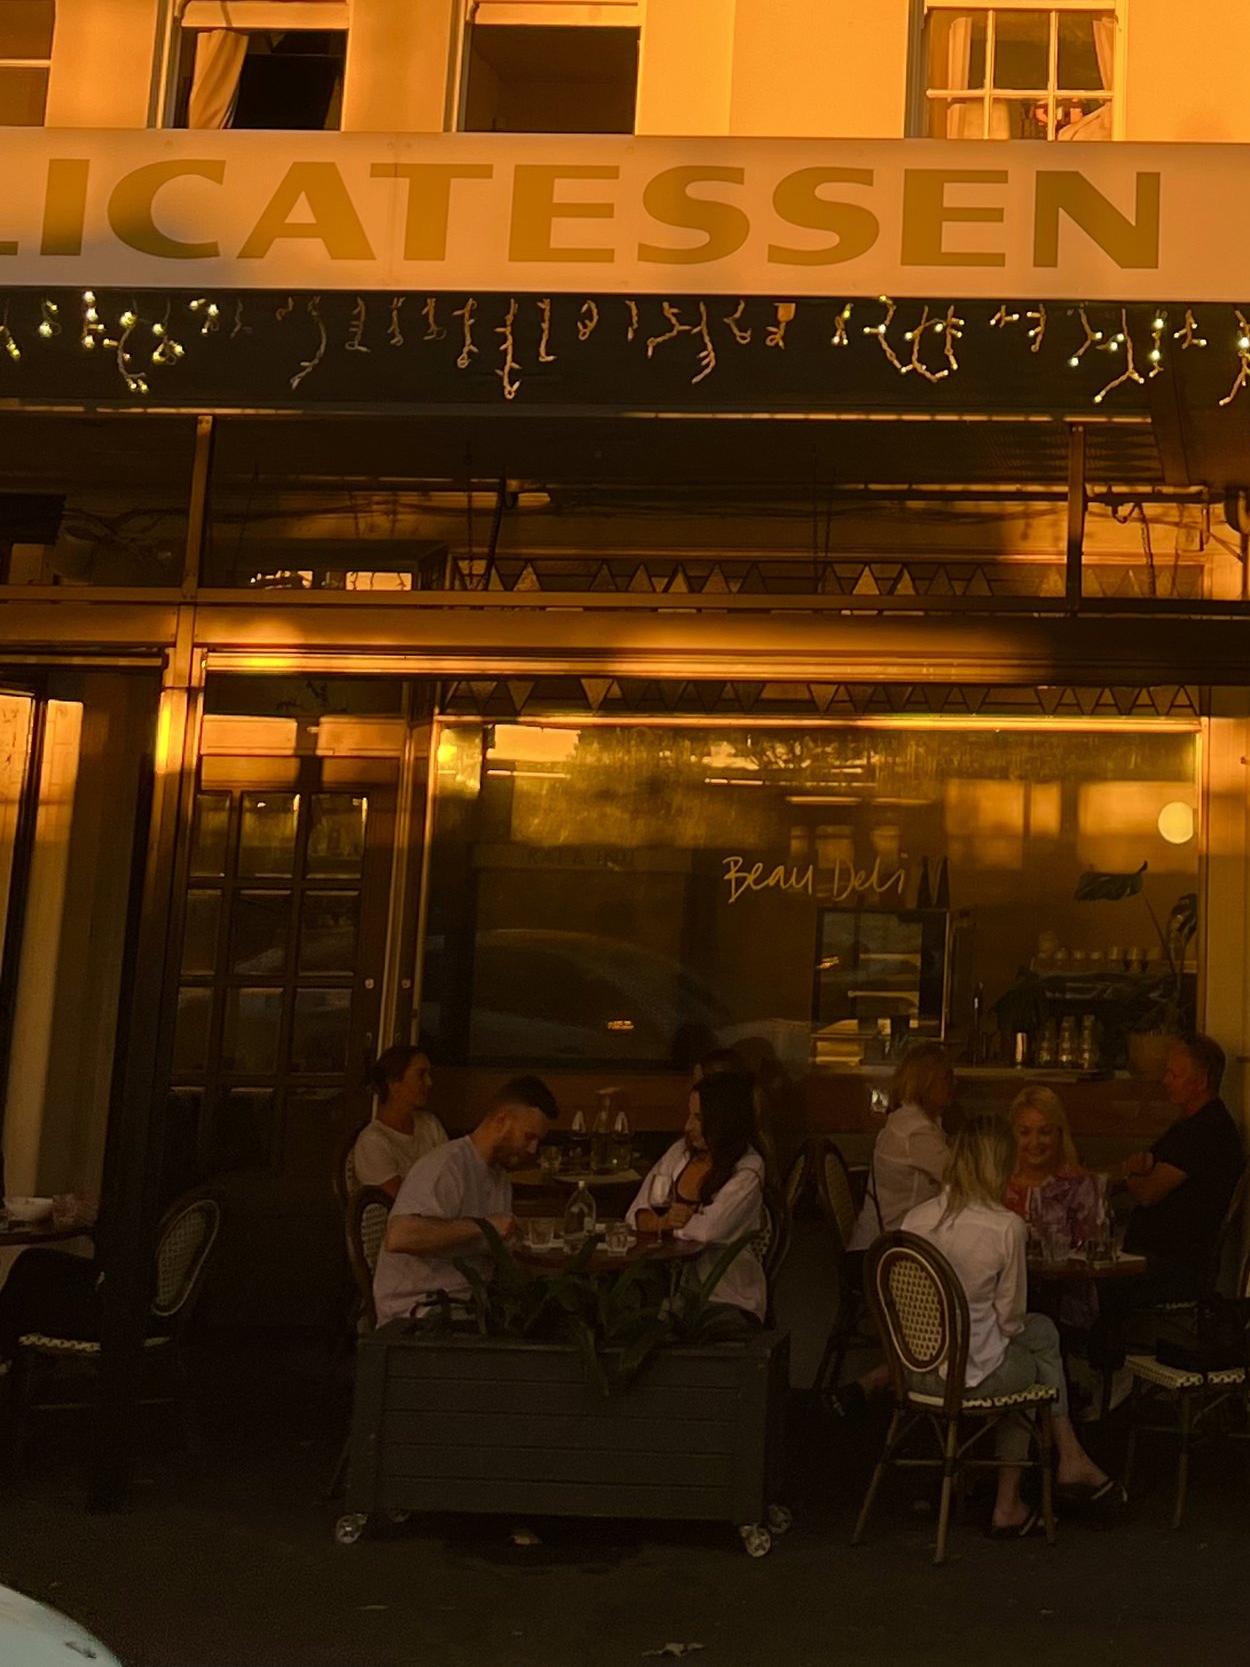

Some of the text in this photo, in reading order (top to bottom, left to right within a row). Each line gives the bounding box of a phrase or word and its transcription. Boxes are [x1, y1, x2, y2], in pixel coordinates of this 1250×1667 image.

[0, 158, 1161, 270] ICATESSEN
[722, 852, 908, 904] Beau Deli
